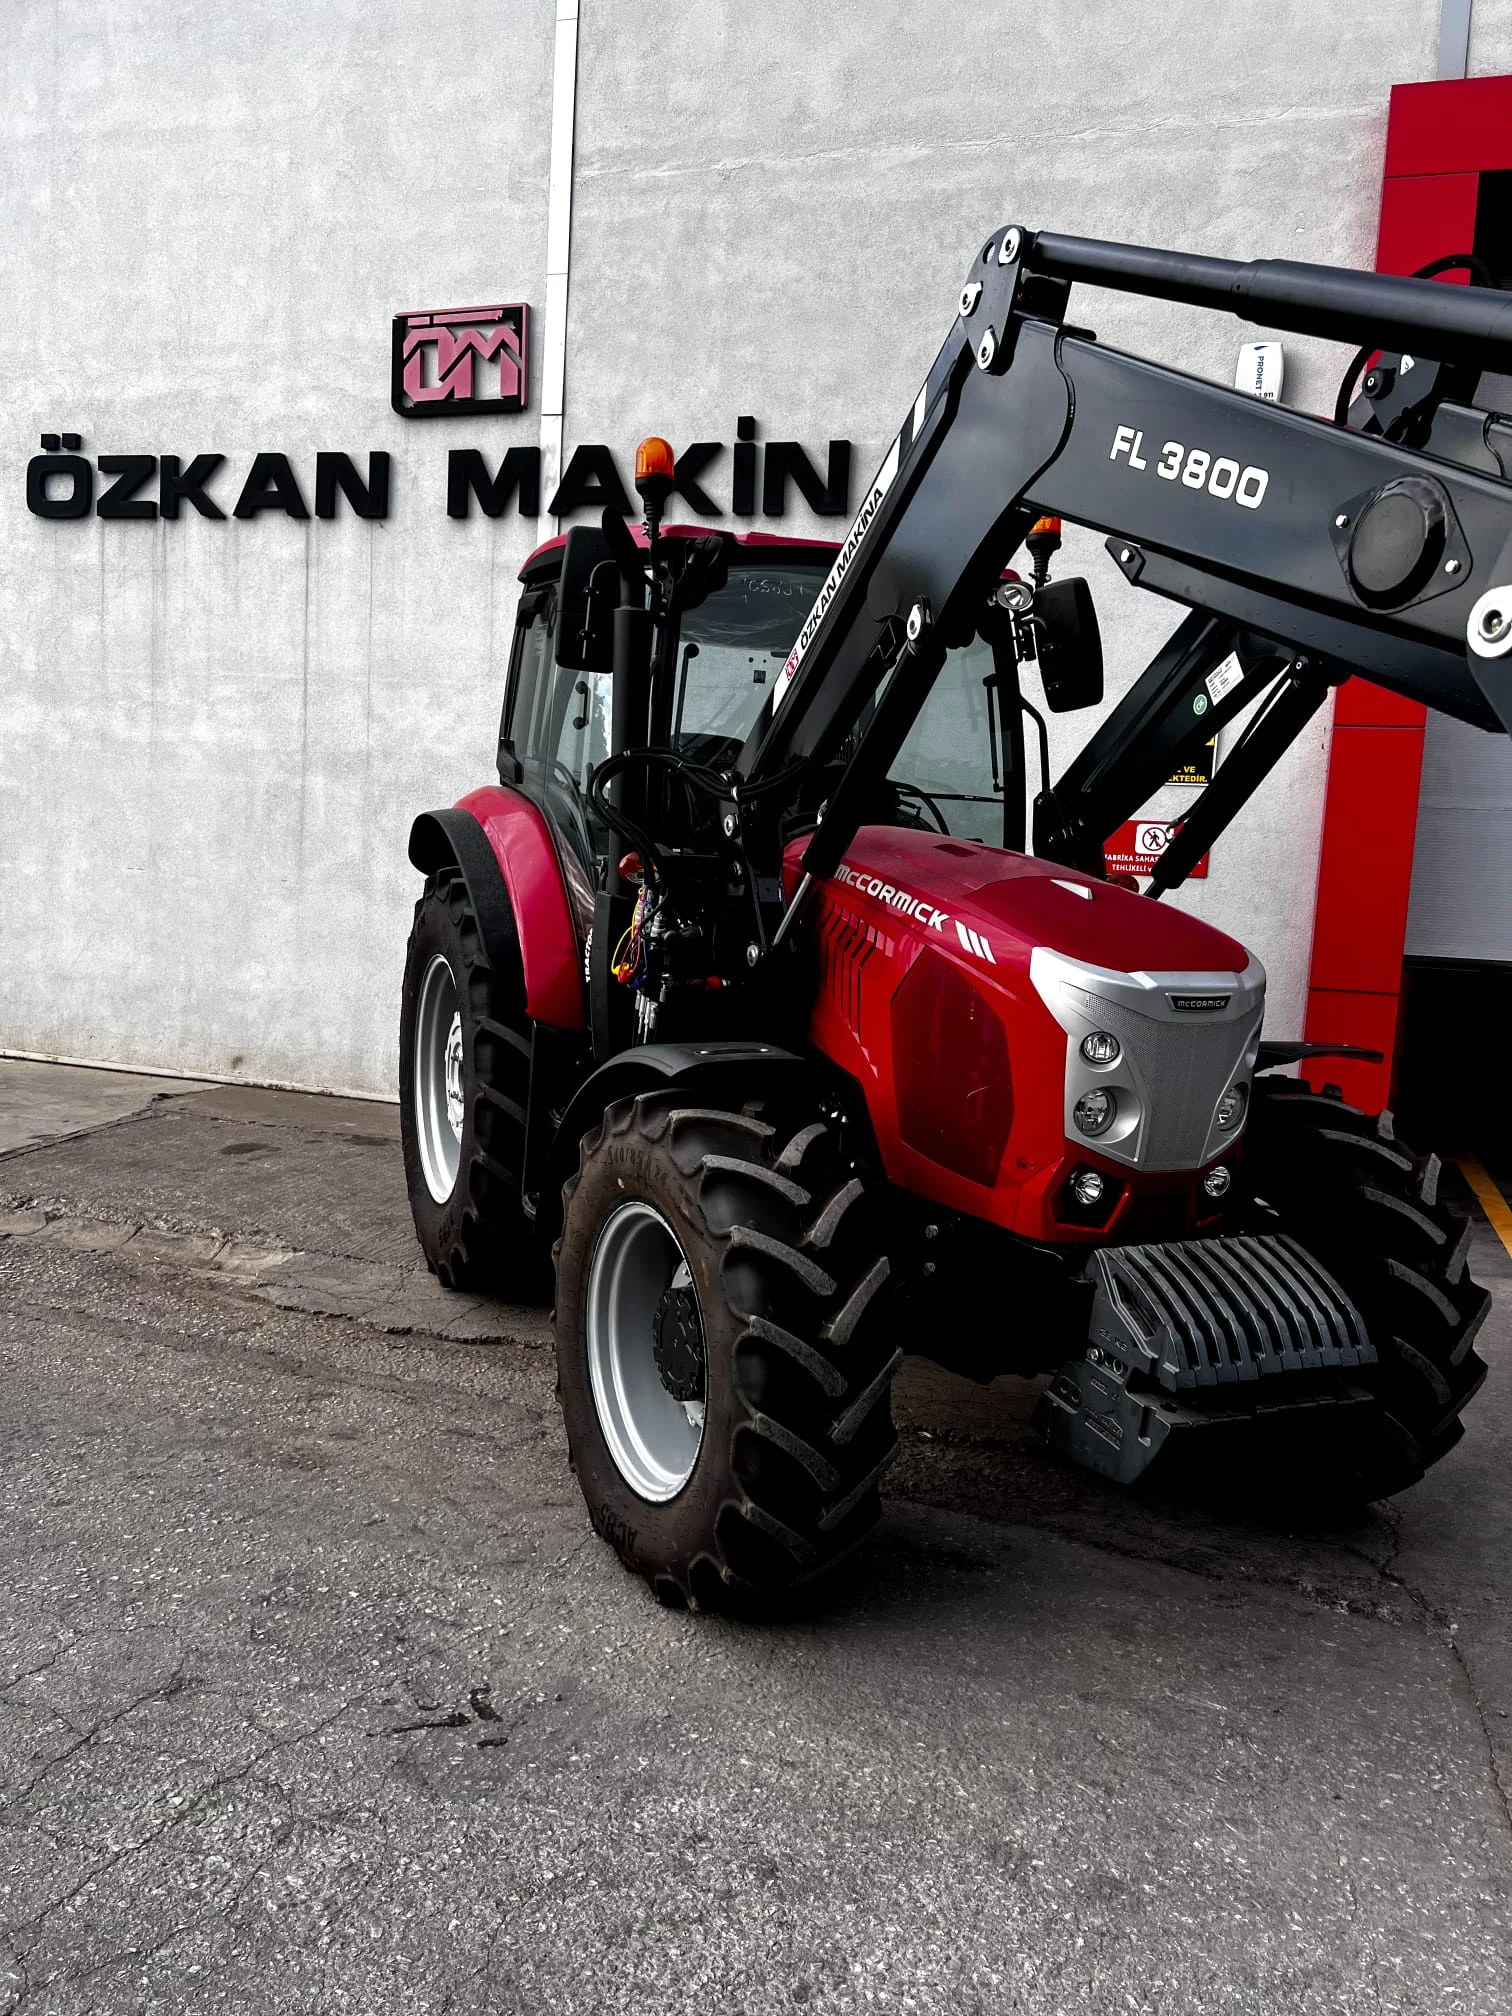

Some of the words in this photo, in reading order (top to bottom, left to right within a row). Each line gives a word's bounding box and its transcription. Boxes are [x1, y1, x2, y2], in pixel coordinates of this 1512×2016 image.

[1255, 355, 1265, 391] PRONET
[27, 432, 390, 520] ÖZKAN
[1109, 424, 1147, 471] FL
[1156, 441, 1269, 510] 3800
[800, 575, 836, 649] ÖZKAN
[837, 487, 884, 579] MAKİNA
[1183, 765, 1196, 773] VE
[1111, 863, 1147, 872] TEHLİKELİ
